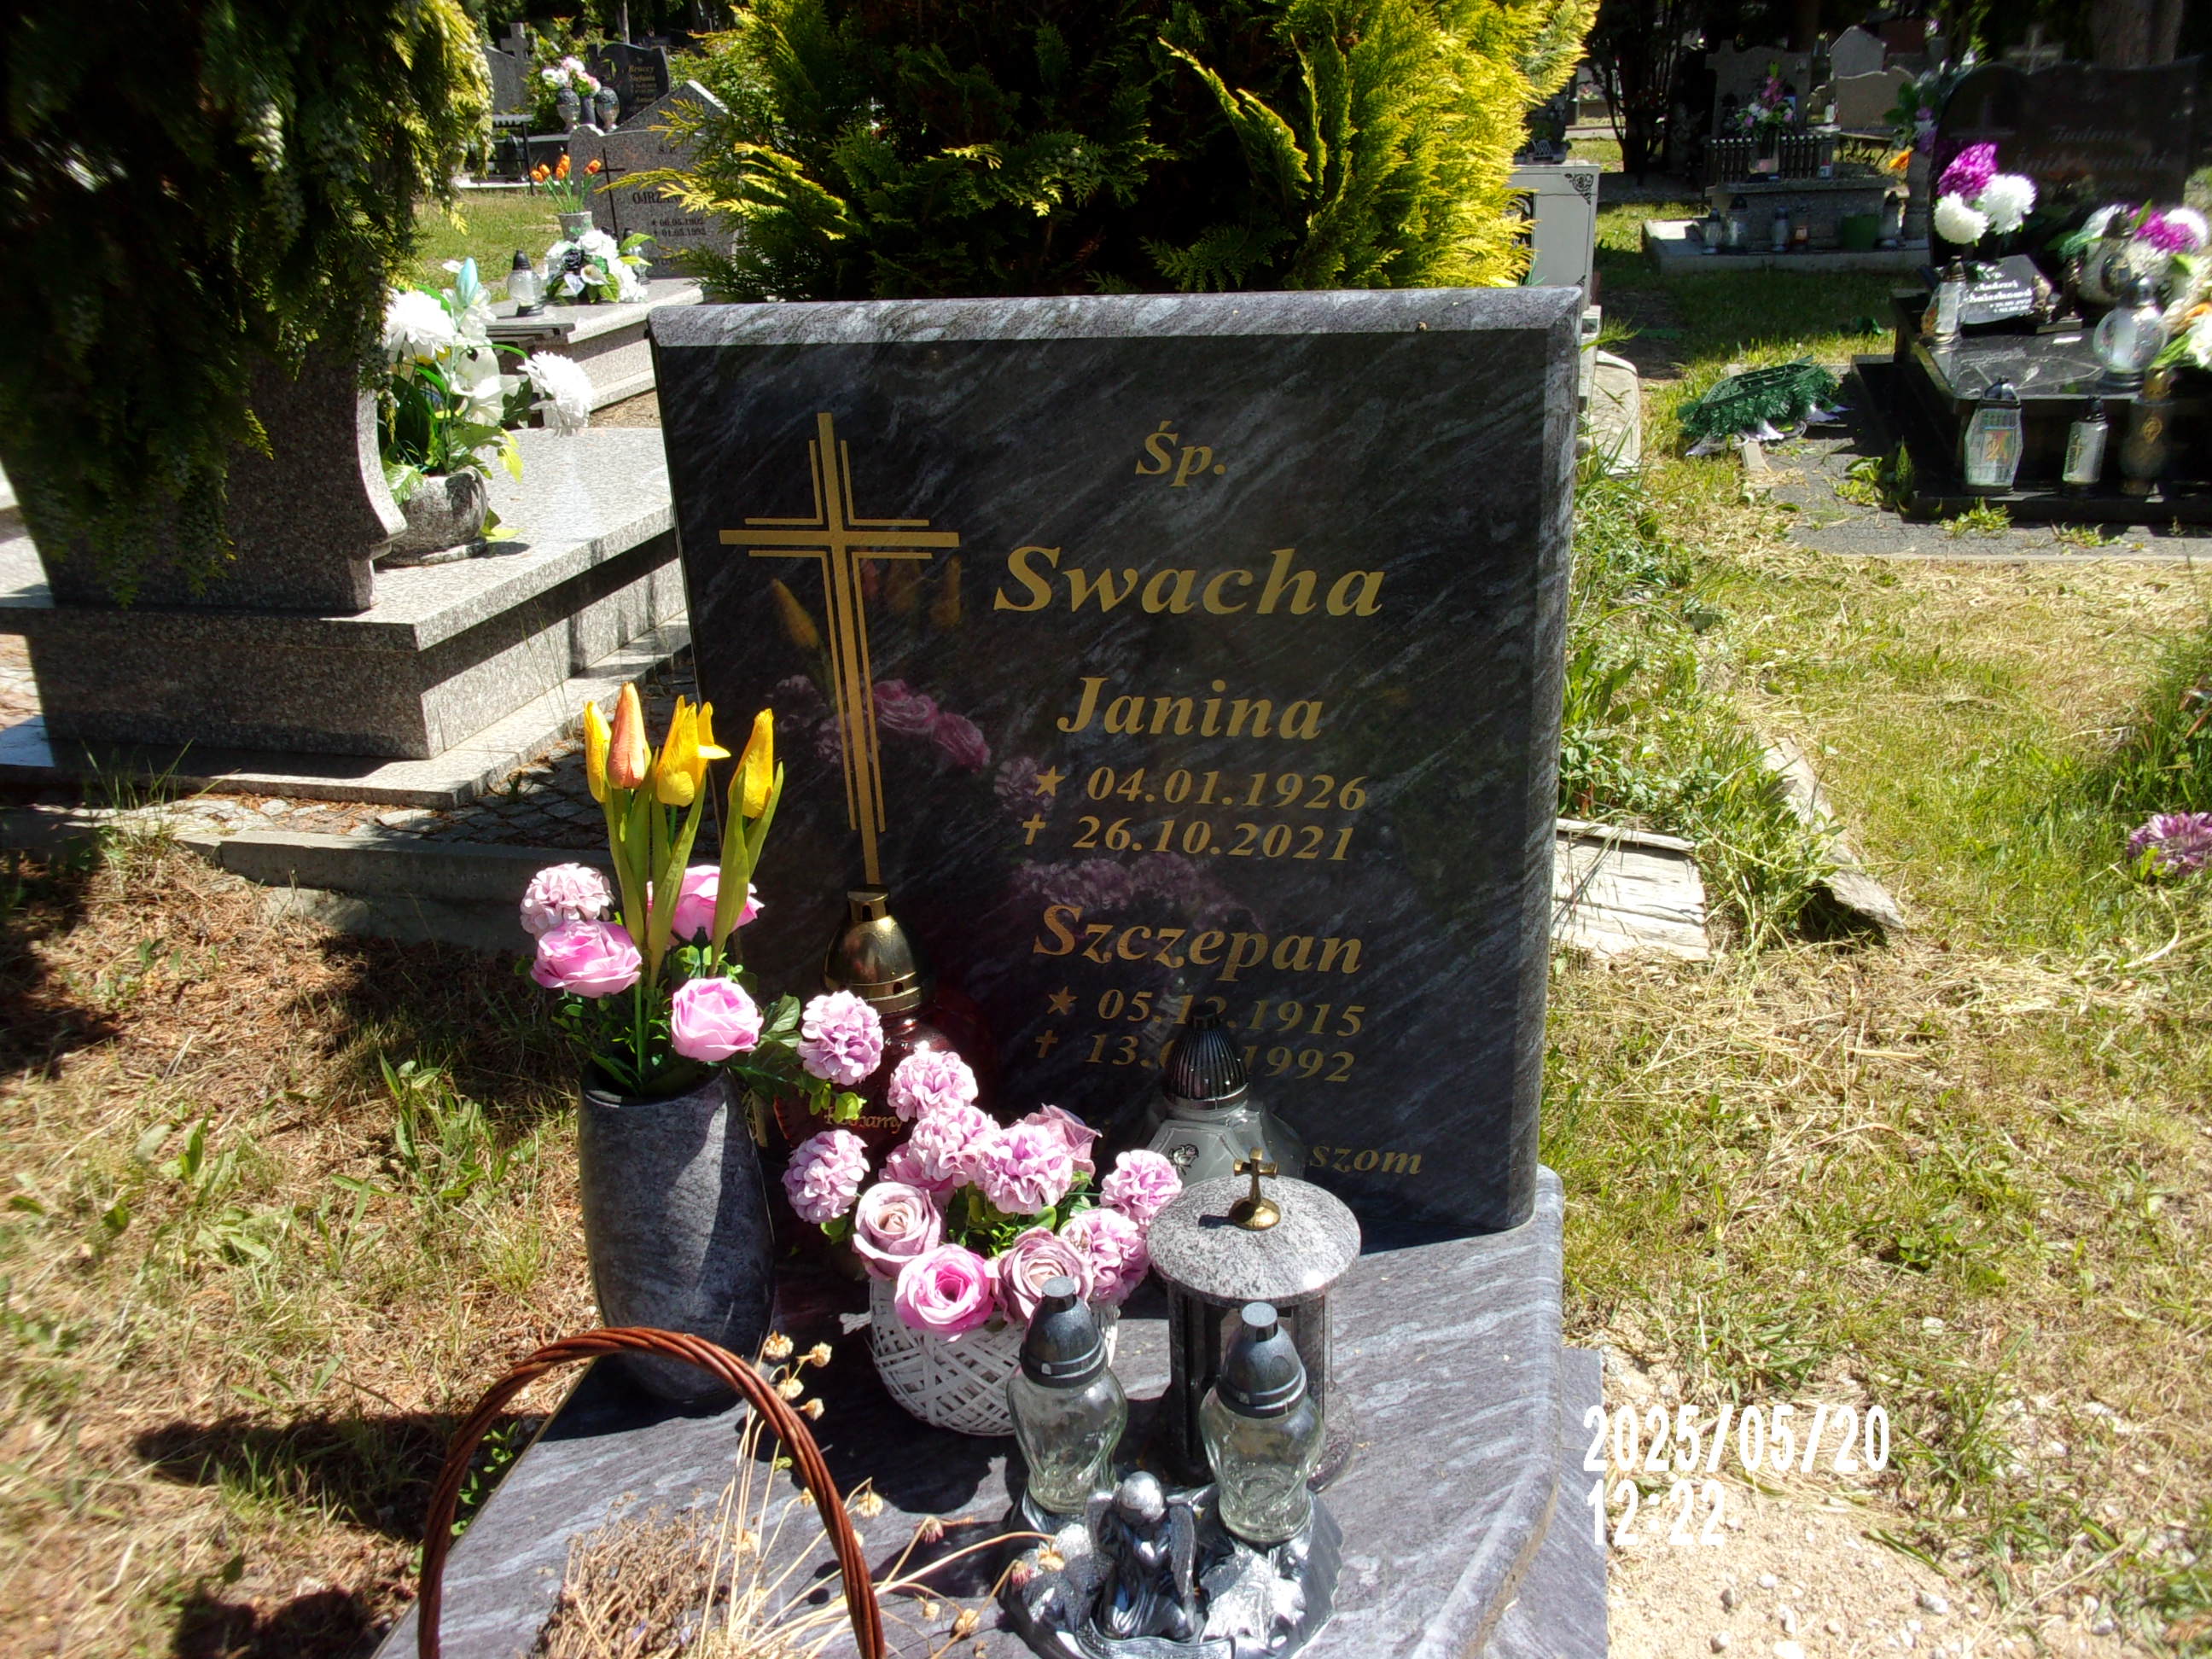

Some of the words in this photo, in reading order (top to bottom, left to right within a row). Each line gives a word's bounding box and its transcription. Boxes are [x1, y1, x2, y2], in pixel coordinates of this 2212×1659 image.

[1135, 420, 1226, 487] Śp.
[992, 545, 1385, 617] Swacha
[1056, 677, 1324, 740] Janina
[1086, 766, 1368, 811] 04.01.1926
[1072, 815, 1354, 861] 26.10.2021
[1033, 904, 1363, 981] Szczepan
[1309, 1145, 1423, 1175] szom
